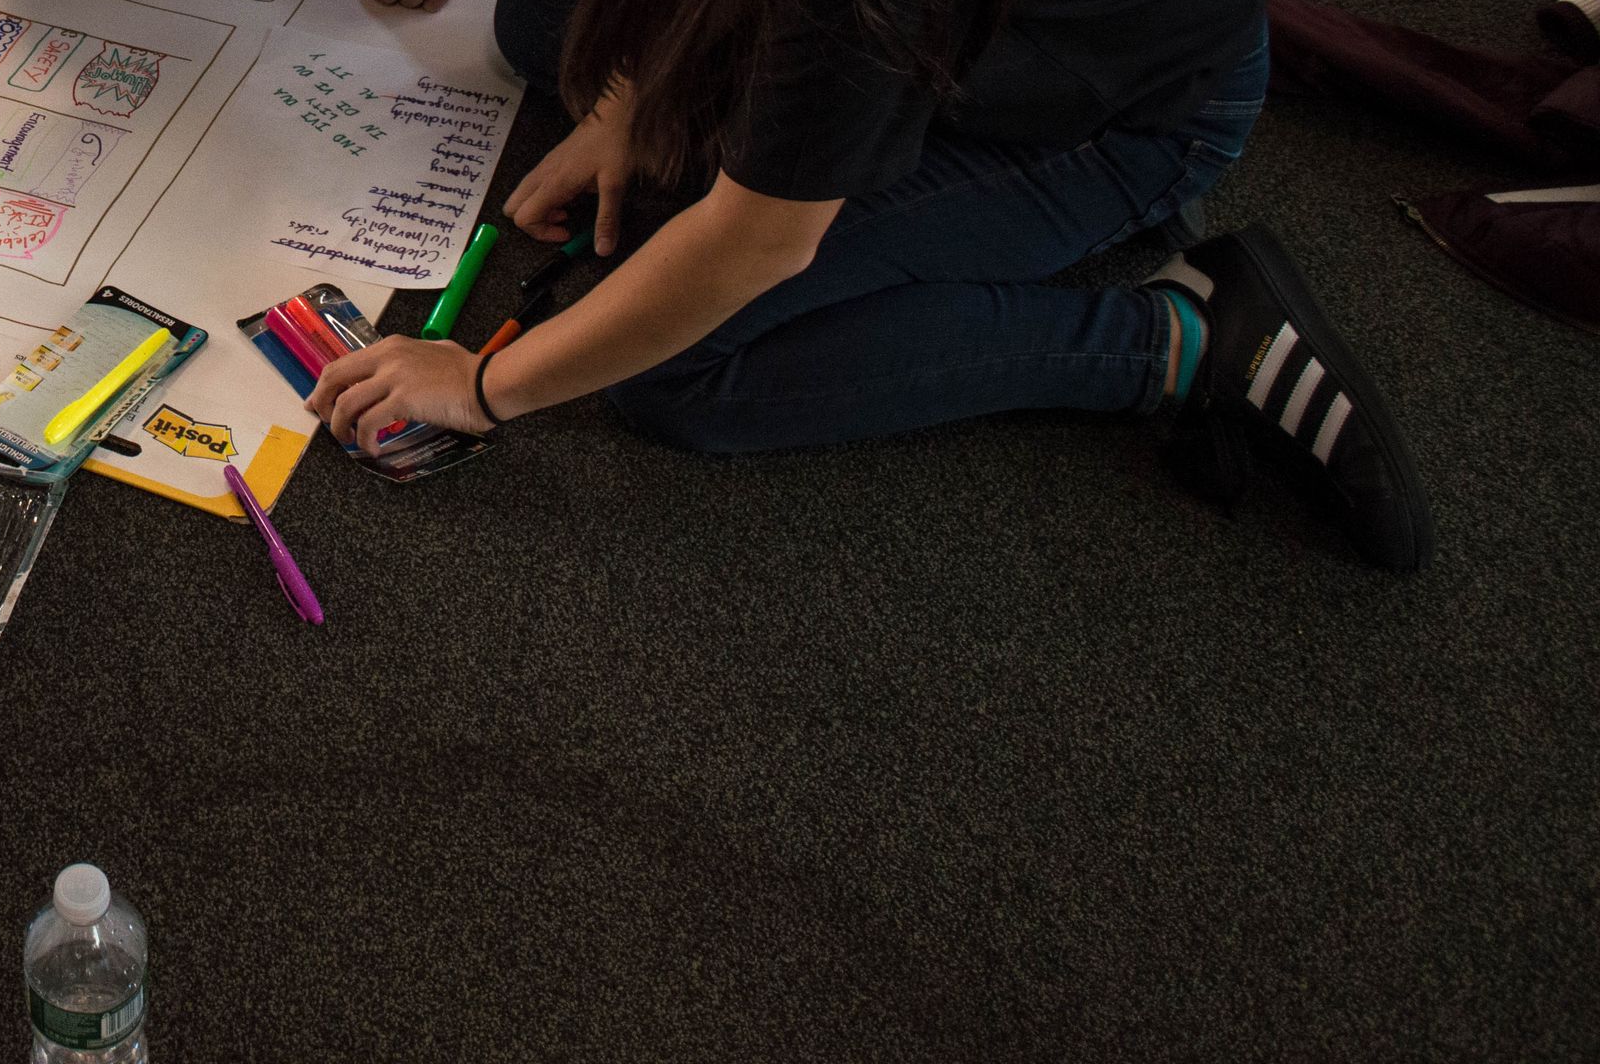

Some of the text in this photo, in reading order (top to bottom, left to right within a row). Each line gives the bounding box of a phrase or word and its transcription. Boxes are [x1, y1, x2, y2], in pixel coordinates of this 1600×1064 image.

[23, 39, 71, 83] SAFETY
[430, 158, 481, 182] Agency
[289, 220, 440, 262] Celebrating risks
[102, 288, 176, 327] RESALTADORES 4
[1247, 335, 1273, 381] SUPERSTAR
[153, 417, 230, 454] Post-it
